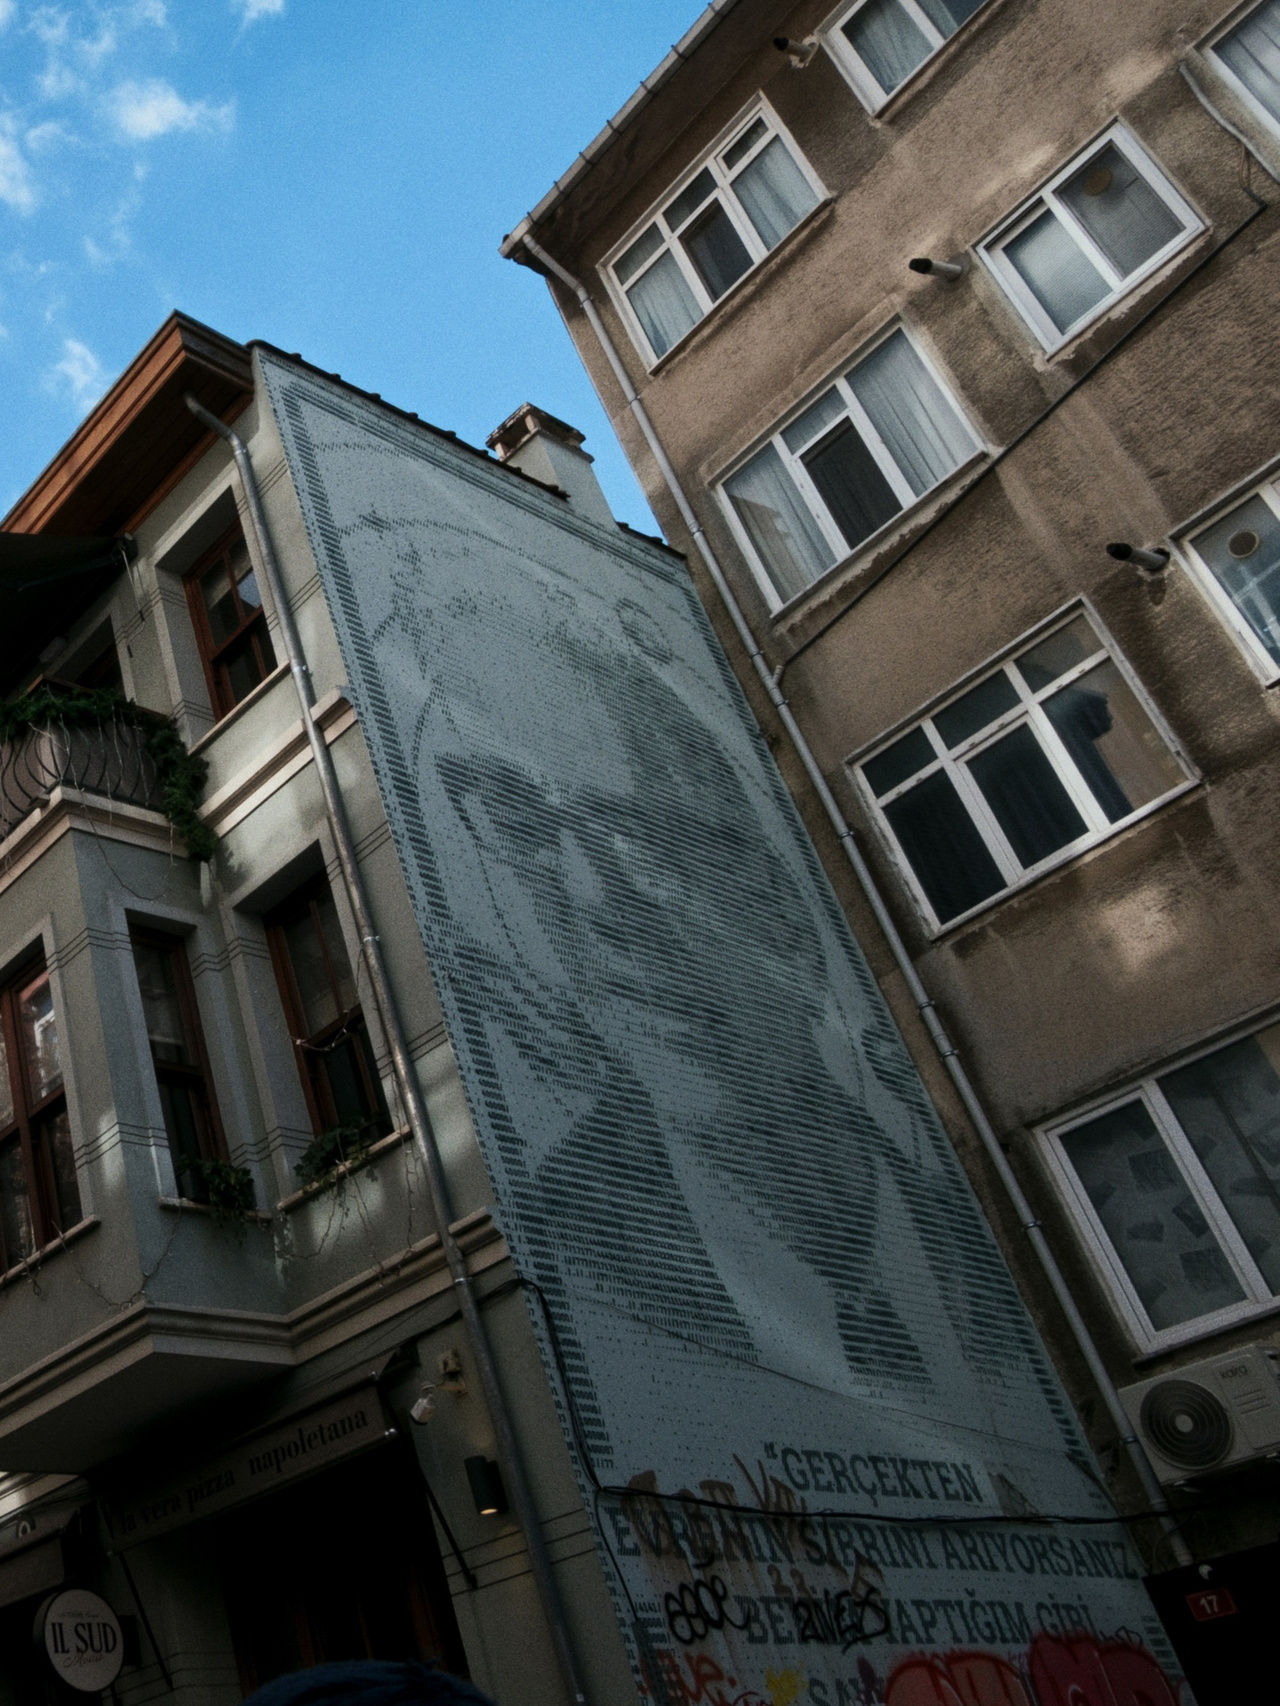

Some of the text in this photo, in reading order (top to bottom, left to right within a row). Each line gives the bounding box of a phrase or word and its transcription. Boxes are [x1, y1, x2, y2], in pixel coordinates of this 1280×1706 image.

[120, 1410, 368, 1534] la vera pizza napoletana
[939, 1526, 1139, 1581] ARIYORSANIZ
[1200, 1593, 1219, 1615] 17
[51, 1622, 118, 1654] IL SUD
